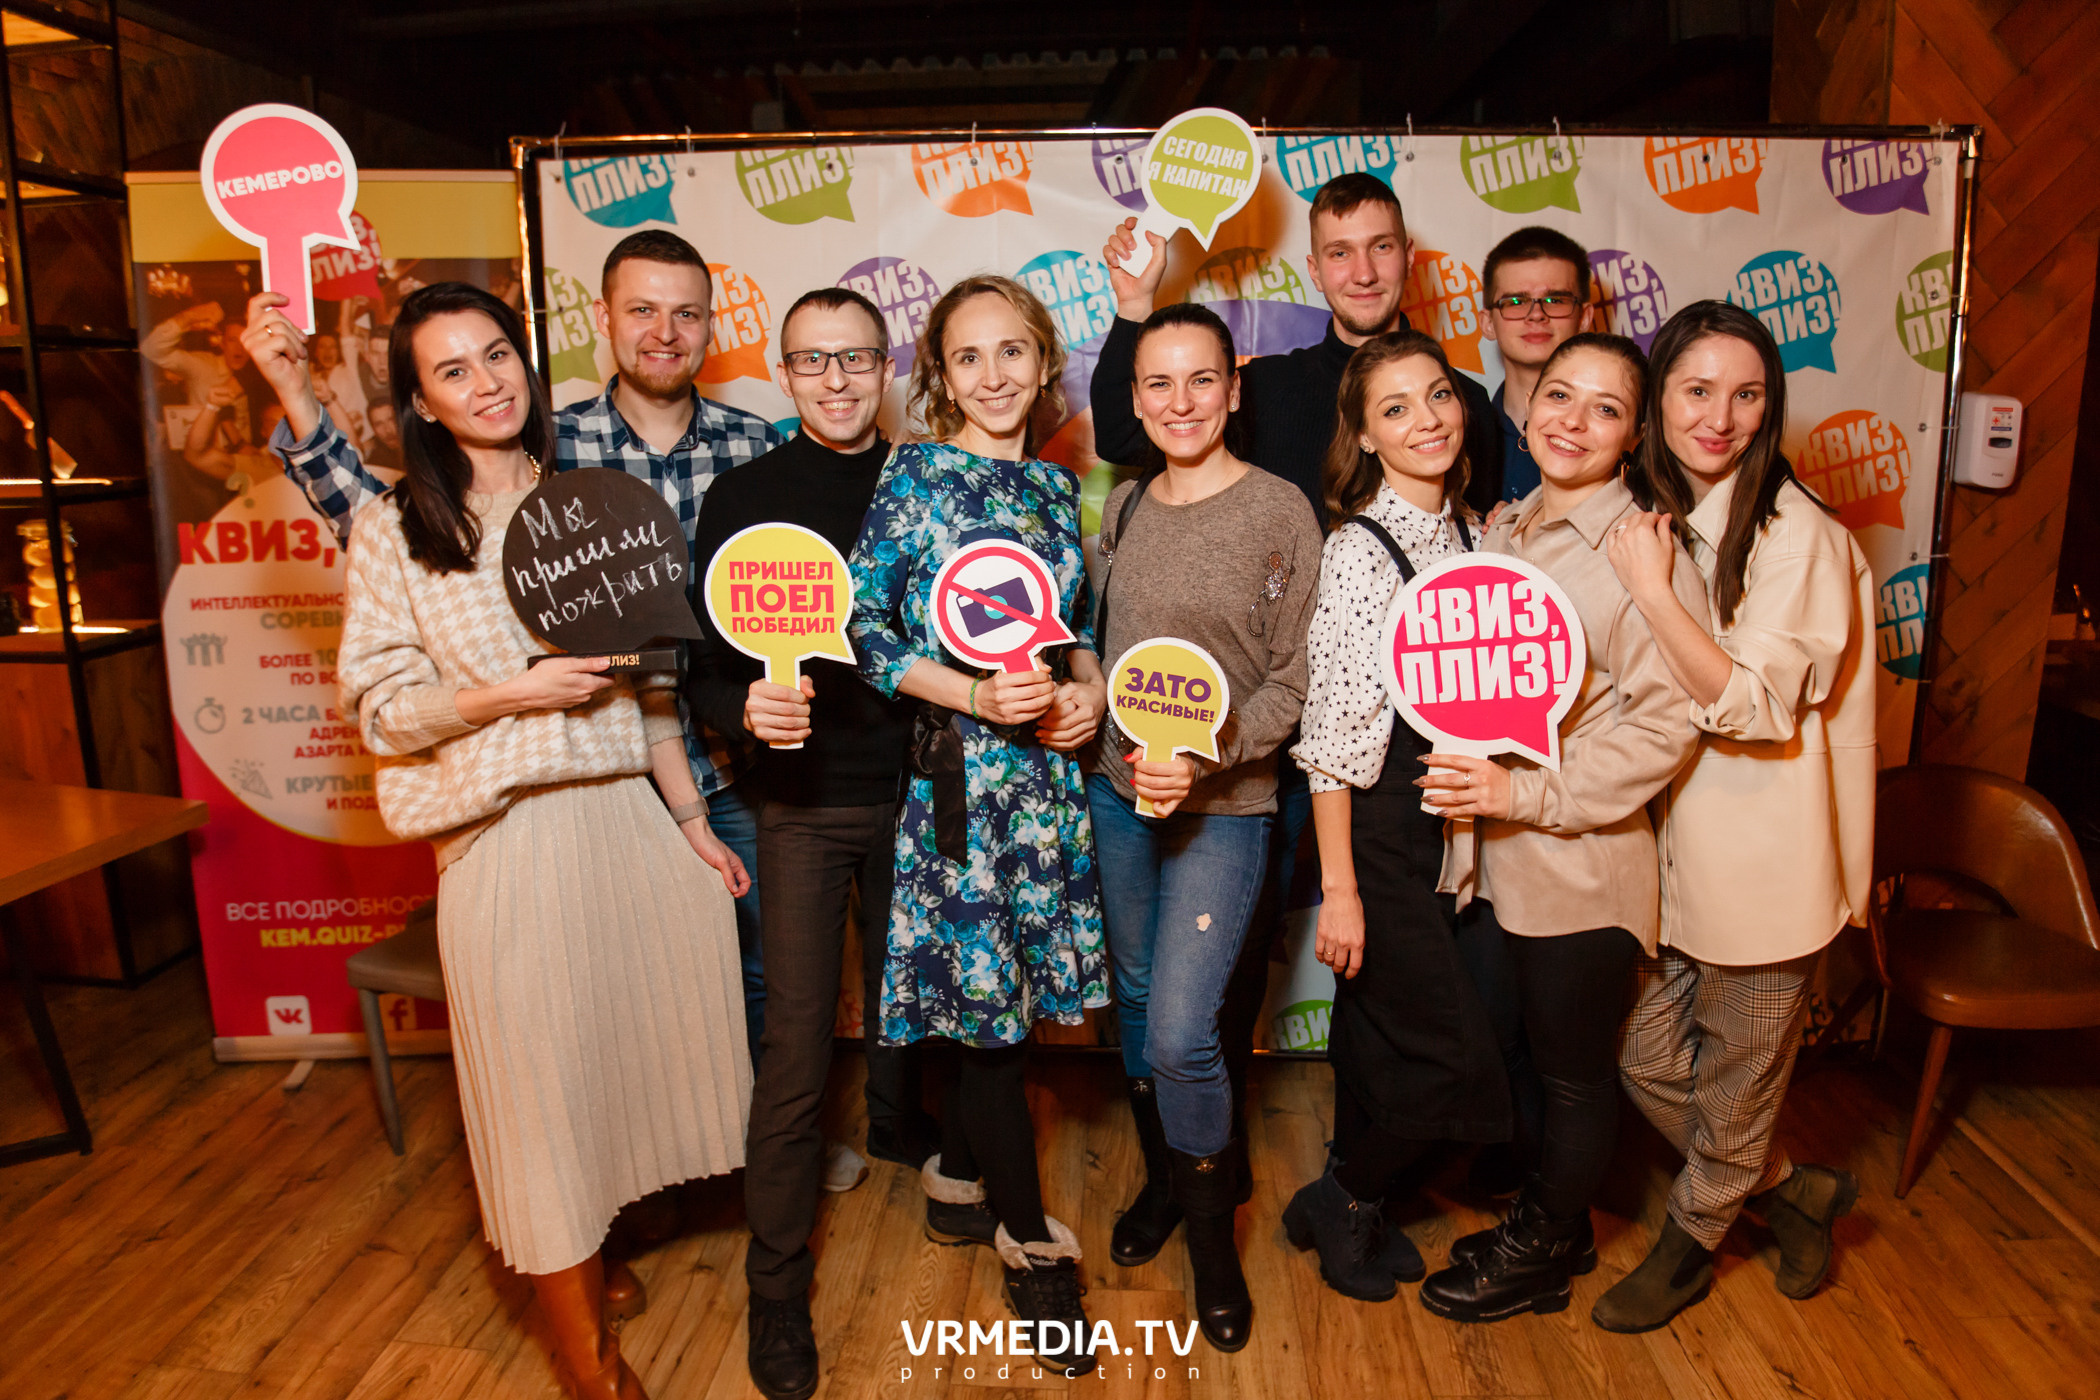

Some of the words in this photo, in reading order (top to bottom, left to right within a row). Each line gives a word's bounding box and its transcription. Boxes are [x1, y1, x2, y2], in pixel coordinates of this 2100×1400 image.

[1163, 135, 1248, 171] СЕГОДНЯ
[217, 160, 343, 199] КЕМЕРОВО
[1162, 163, 1248, 199] КАПИТАН
[311, 239, 380, 283] ЛИЗ!
[1733, 255, 1833, 311] КВИЗ,
[1804, 414, 1903, 474] КВИЗ,
[521, 497, 600, 549] Мы
[176, 518, 337, 569] КВИЗ,
[512, 521, 673, 610] пришли
[729, 561, 834, 580] ПРИШЕЛ
[730, 583, 834, 613] ПОЕЛ
[1404, 580, 1560, 646] КВИЗ,
[732, 616, 835, 636] ПОБЕДИЛ
[259, 653, 312, 669] БОЛЕЕ
[605, 654, 640, 667] ЛИЗ!
[1401, 640, 1567, 704] ПЛИЗ!
[290, 672, 314, 686] ПО
[1124, 667, 1212, 703] ЗАТО
[241, 707, 254, 724] 2
[259, 704, 320, 724] ЧАСА
[1116, 695, 1215, 723] КРАСИВЫЕ!
[294, 744, 350, 759] АЗАРТА
[284, 774, 373, 795] КРУТЫЕ
[326, 797, 338, 811] И
[226, 902, 271, 921] ВСЕ
